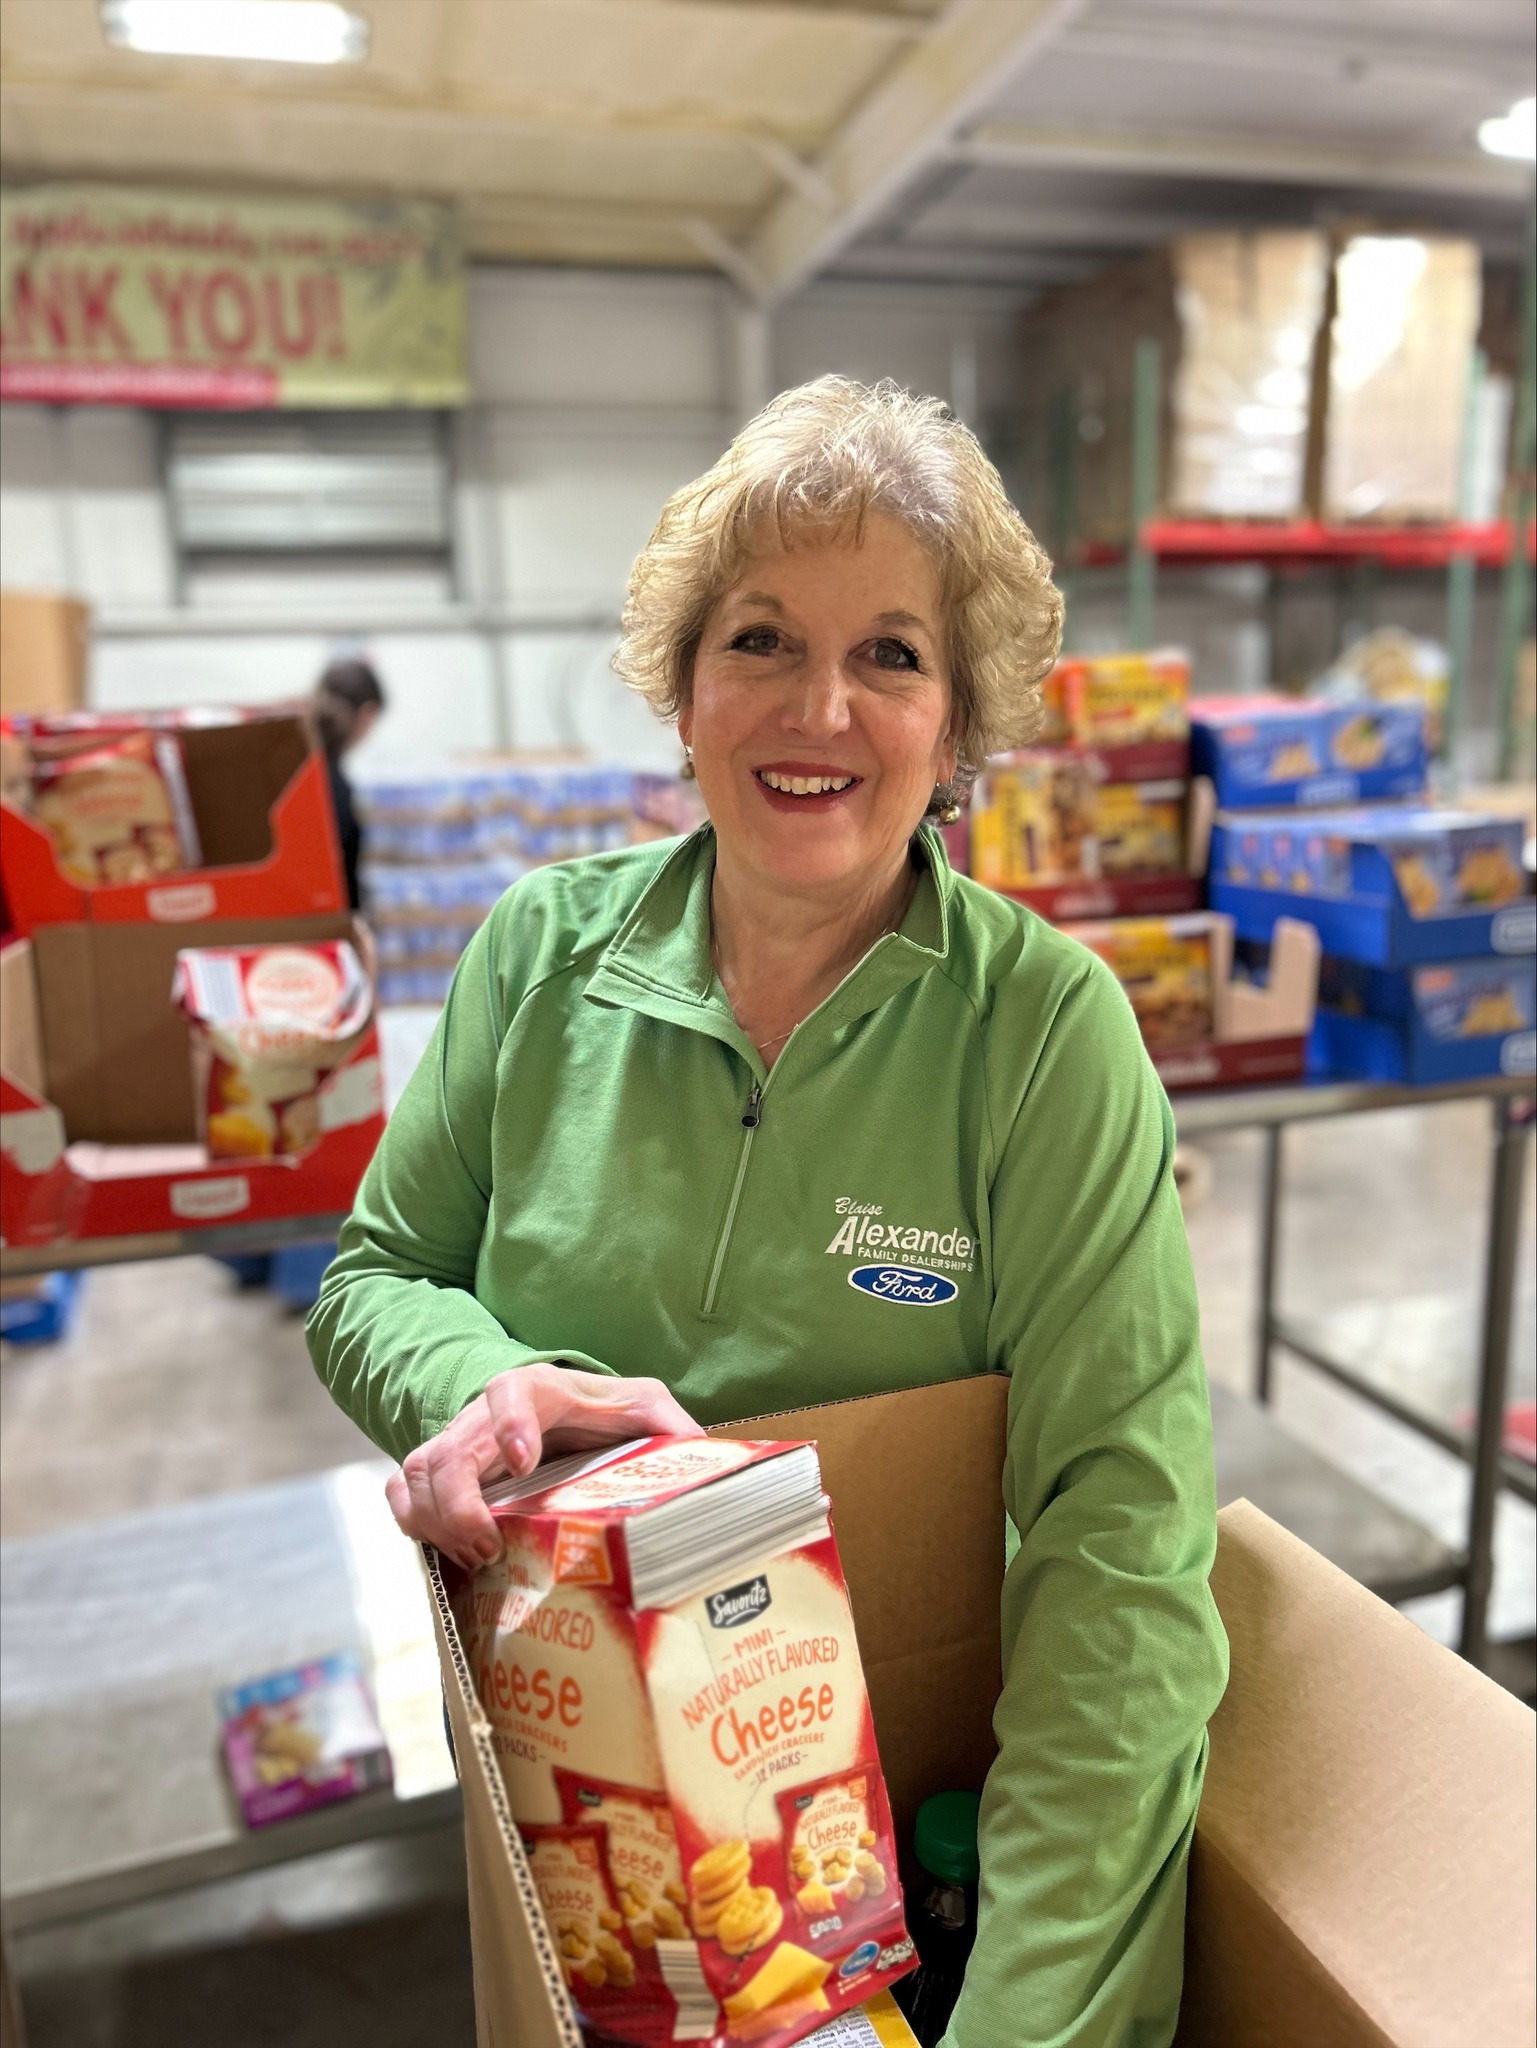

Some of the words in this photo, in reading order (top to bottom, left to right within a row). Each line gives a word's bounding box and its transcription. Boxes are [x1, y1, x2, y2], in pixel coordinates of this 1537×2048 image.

[0, 263, 134, 351] NK
[144, 266, 346, 361] YOU!
[834, 1196, 884, 1216] Blaise
[857, 1246, 898, 1262] FAMILY
[902, 1253, 974, 1273] DEALERSHIPS
[872, 1270, 938, 1301] Ford
[508, 1563, 529, 1590] MINI
[711, 1579, 768, 1625] Savoritz
[733, 1628, 775, 1659] MINI
[470, 1634, 584, 1729] heese
[681, 1653, 766, 1731] NATURALLY
[767, 1636, 840, 1676] FLAVORED
[711, 1683, 835, 1767] Cheese
[734, 1744, 780, 1782] SANDWICH
[781, 1732, 825, 1751] CRACKERS
[769, 1751, 801, 1777] PACKS
[808, 1821, 857, 1850] Cheese
[538, 1882, 594, 1913] Cheese
